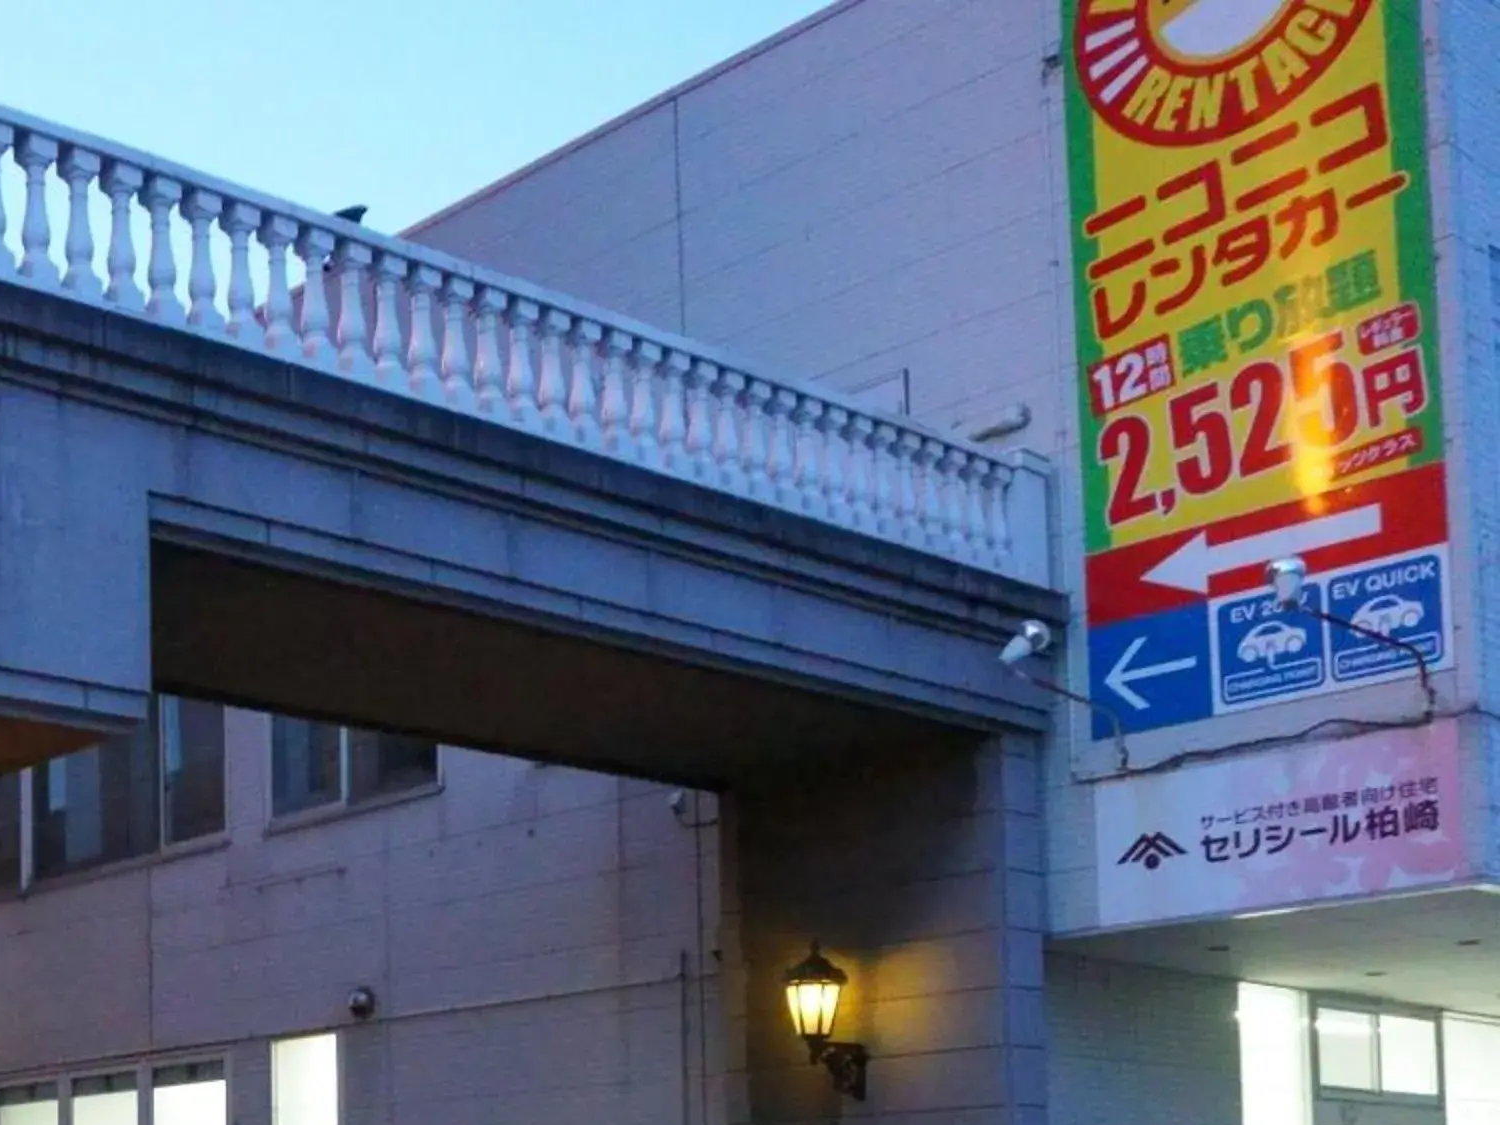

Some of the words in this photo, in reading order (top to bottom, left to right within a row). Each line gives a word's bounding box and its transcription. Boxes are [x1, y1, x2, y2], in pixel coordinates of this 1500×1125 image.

[1121, 0, 1357, 132] RENTAC
[1085, 82, 1389, 281] ニコニコ
[1094, 172, 1407, 341] レンタカー
[1230, 601, 1257, 623] EV
[1332, 581, 1359, 600] EV
[1365, 560, 1436, 592] QUICK
[1200, 777, 1439, 830] サービス付き高齢者向け住宅
[1201, 798, 1440, 874] セリシール柏崎
